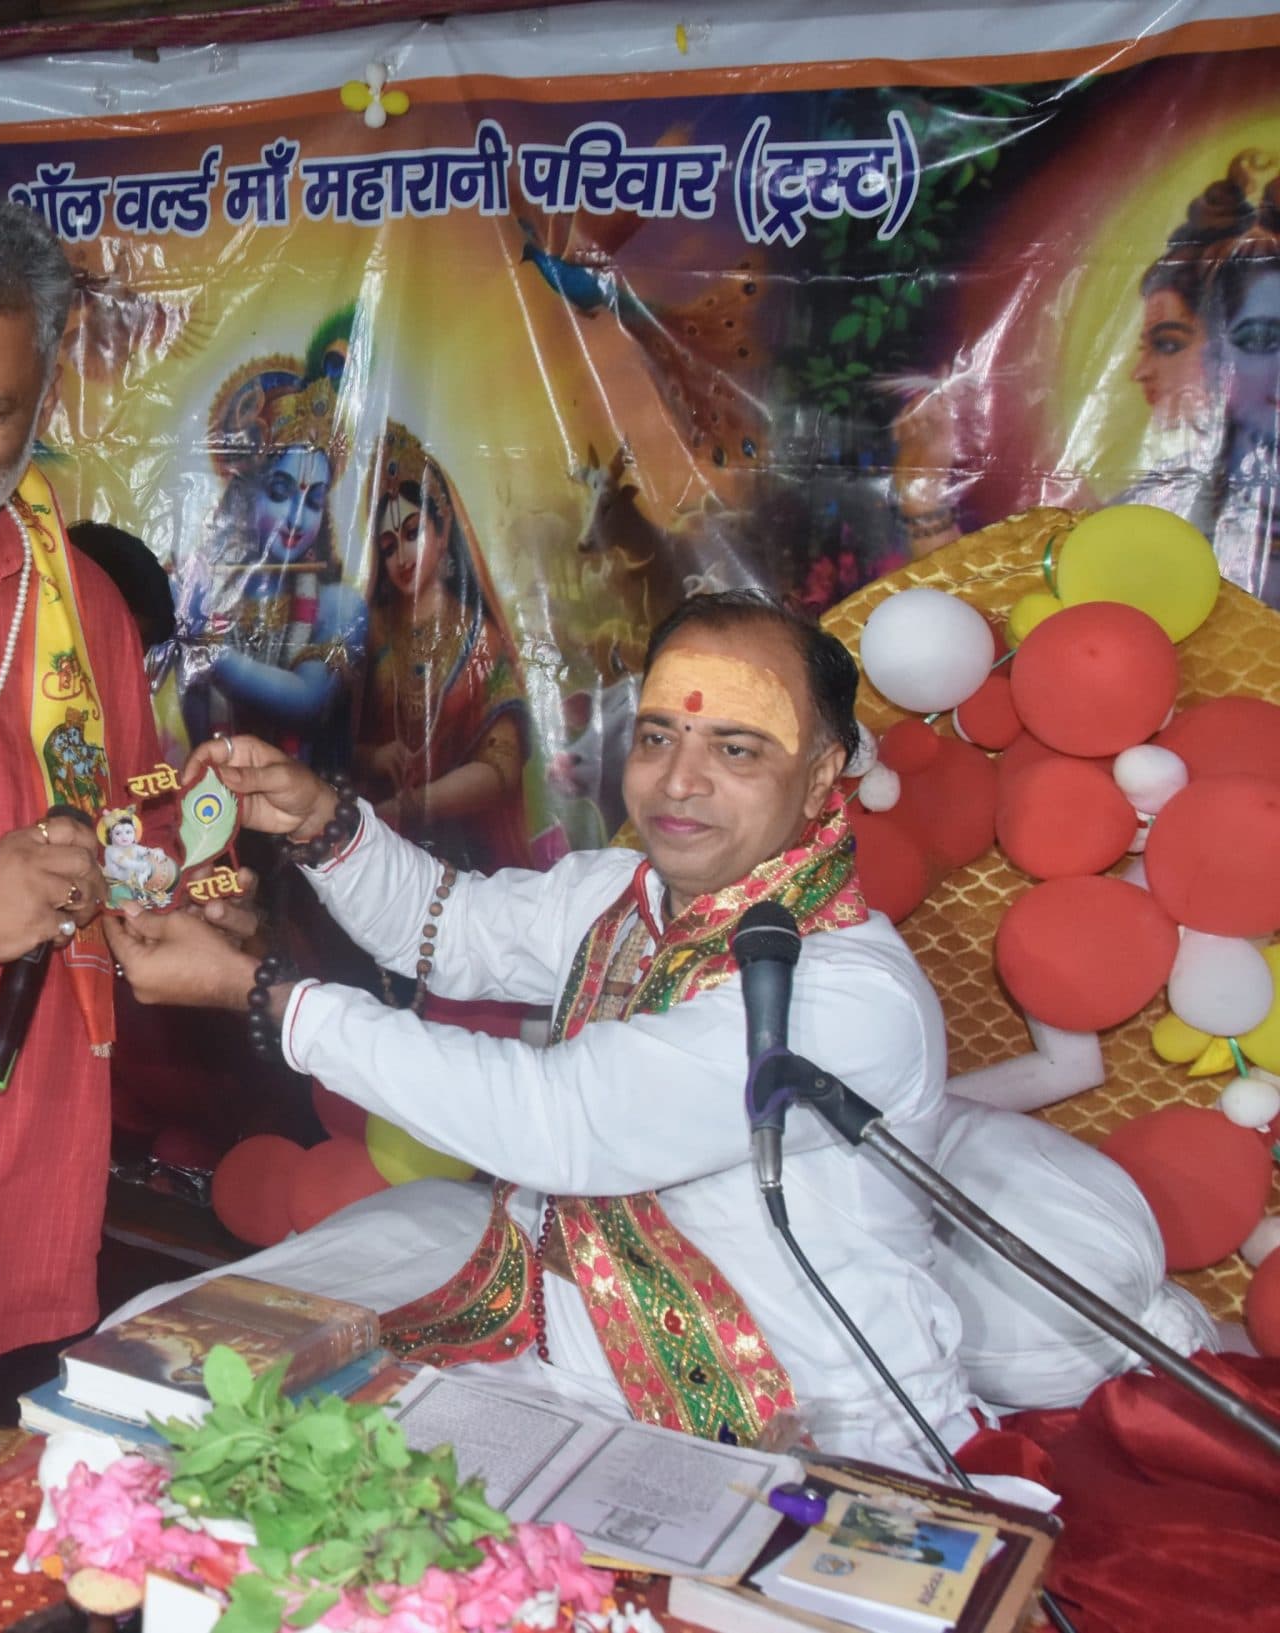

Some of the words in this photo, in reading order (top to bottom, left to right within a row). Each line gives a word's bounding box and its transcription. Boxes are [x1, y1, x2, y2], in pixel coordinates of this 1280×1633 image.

[114, 144, 222, 238] वर्ल्ड
[224, 136, 300, 226] माँ
[299, 118, 513, 226] महारानी
[518, 121, 726, 219] परिवार
[734, 110, 920, 248] (ट्रस्ट)
[128, 763, 181, 796] राधे
[187, 866, 243, 900] राधे
